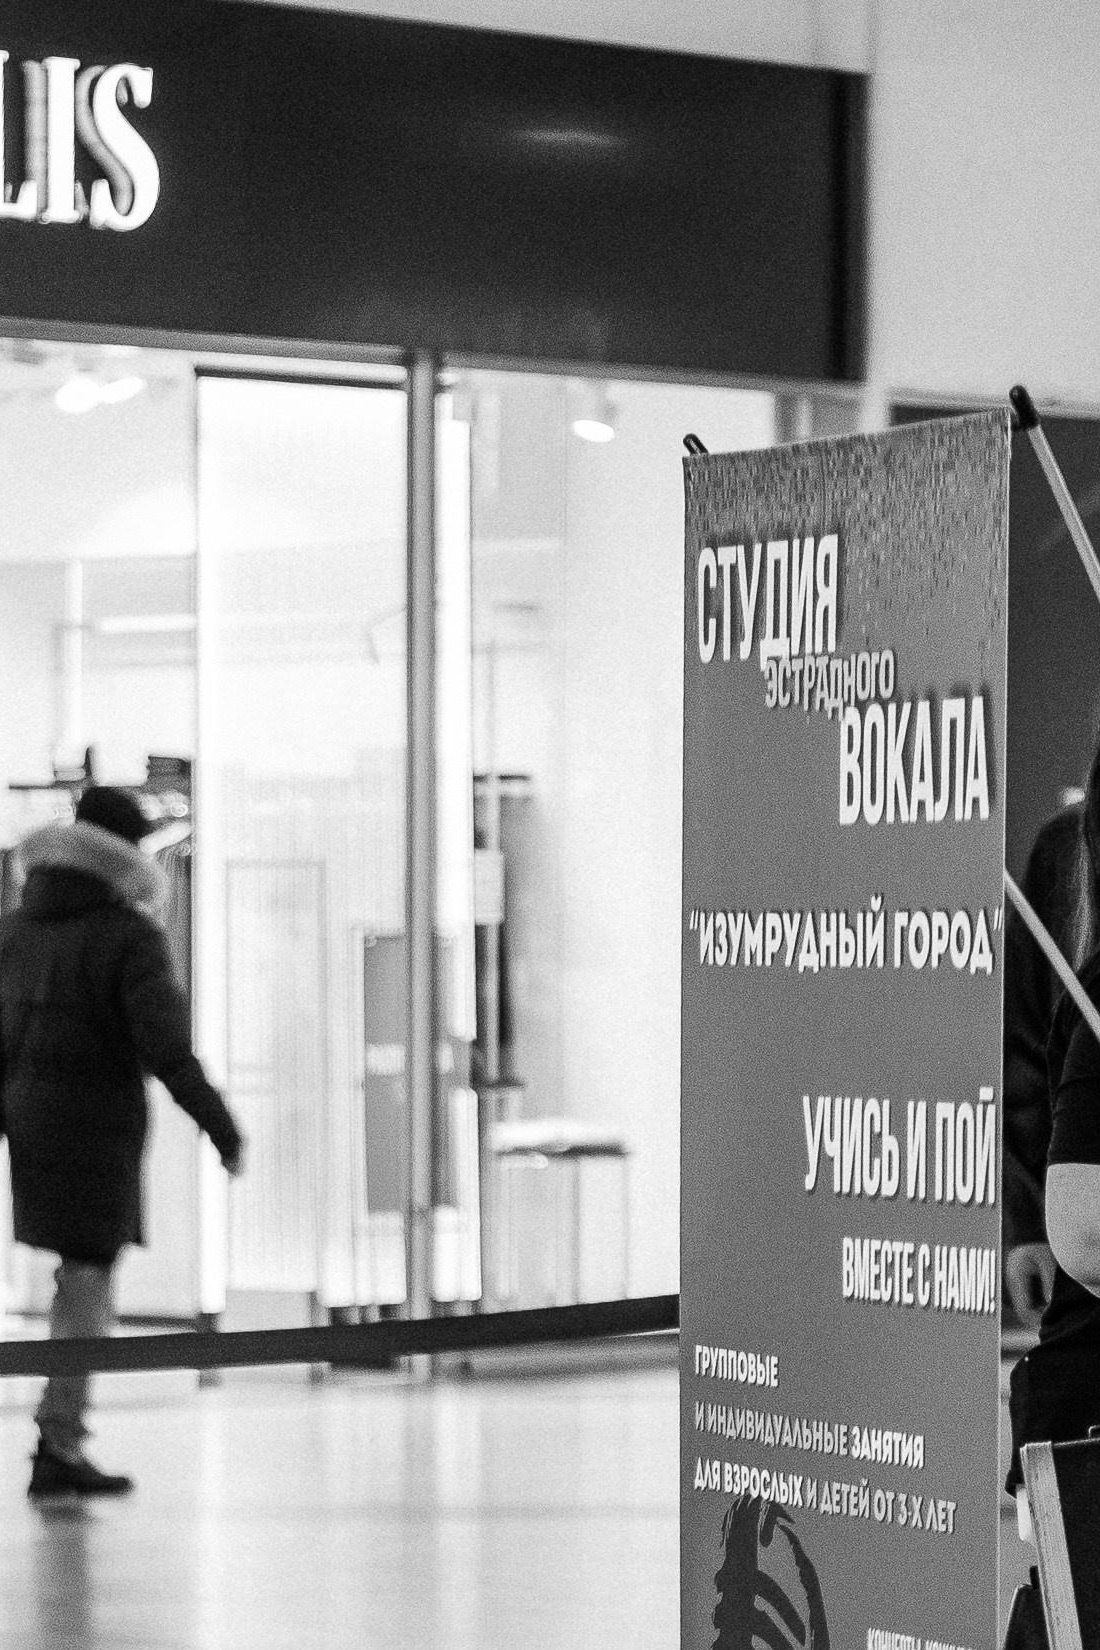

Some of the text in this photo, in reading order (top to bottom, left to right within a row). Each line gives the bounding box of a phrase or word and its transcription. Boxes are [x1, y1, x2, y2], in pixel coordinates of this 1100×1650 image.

[698, 534, 838, 671] СТУДИЯ
[764, 649, 894, 721] ЭСТРАДНОГО
[839, 695, 989, 826] ВОКАЛА
[689, 893, 1000, 974] "ИЗУМРУДНЫЙ ГОРОД"
[803, 1086, 996, 1205] УЧИСЬ И ПОЙ
[842, 1237, 996, 1314] ВМЕСТЕ С НАМИ!
[695, 1344, 779, 1388] ГРУППОВЫЕ
[695, 1401, 925, 1469] И ИНДИВИДУАЛЬНЫЕ ЗАНЯТИЯ
[694, 1456, 957, 1534] ДЛЯ ВЗРОСЛЫХ И ДЕТЕЙ ОТ 3-Х ЛЕТ
